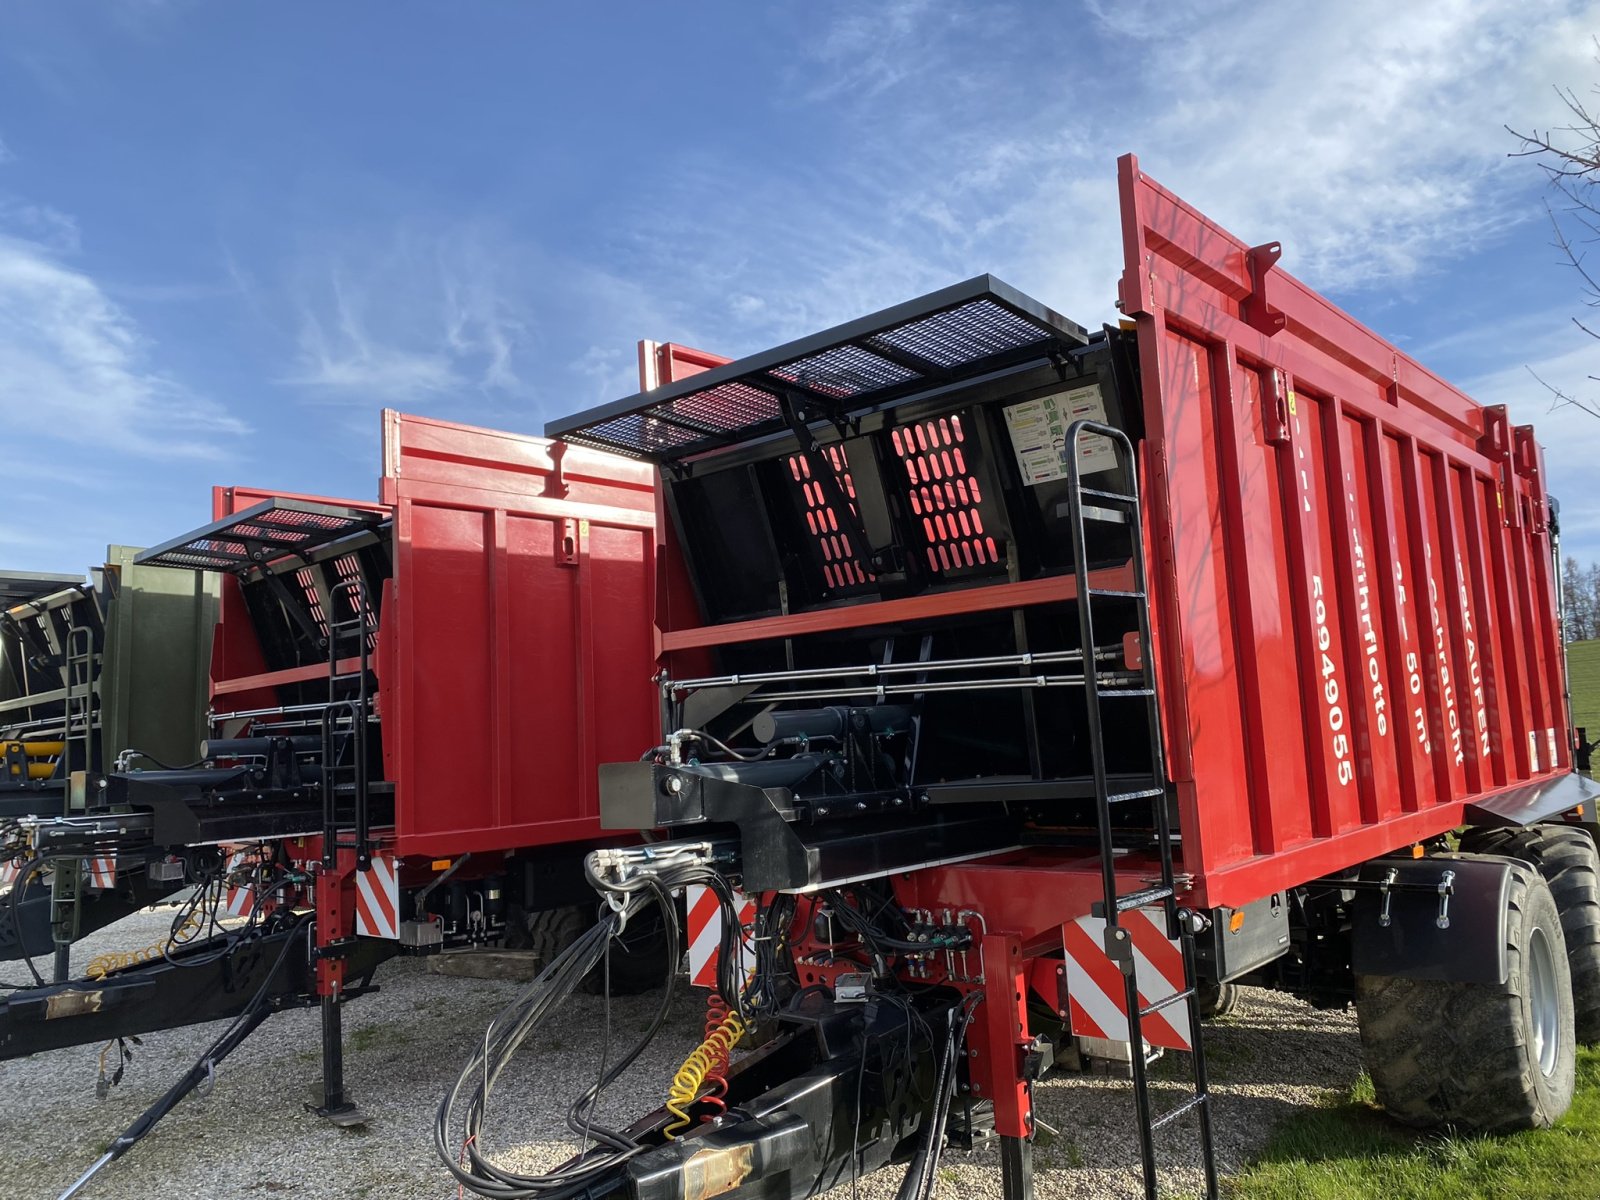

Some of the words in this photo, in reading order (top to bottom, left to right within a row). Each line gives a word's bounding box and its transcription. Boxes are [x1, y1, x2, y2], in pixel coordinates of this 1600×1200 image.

[1312, 575, 1353, 786] 59949055
[1346, 472, 1387, 737] führflotte
[1406, 652, 1421, 695] 50
[1456, 552, 1491, 757] RKAUFEN
